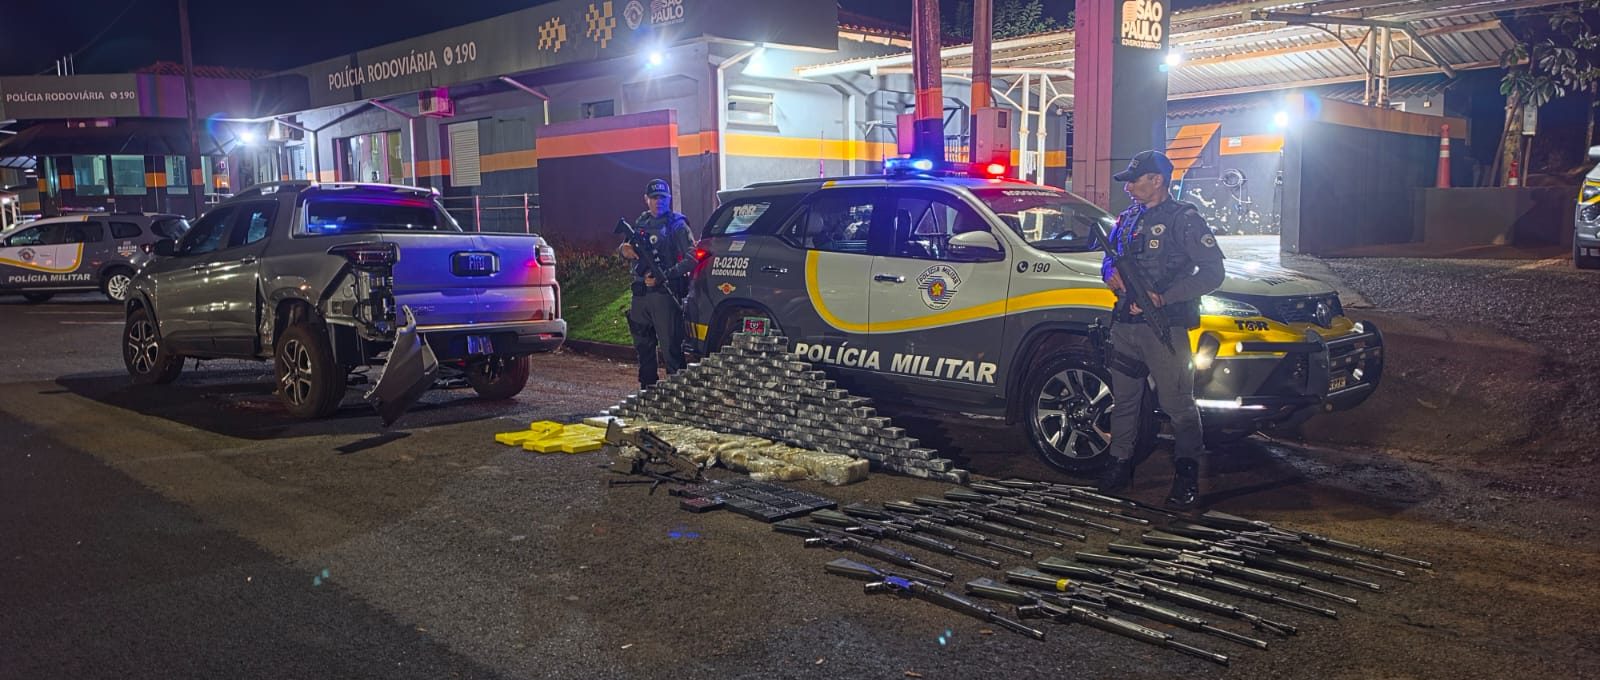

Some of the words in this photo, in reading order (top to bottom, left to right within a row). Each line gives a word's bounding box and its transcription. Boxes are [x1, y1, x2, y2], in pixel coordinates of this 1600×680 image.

[651, 5, 684, 24] PAULO
[1121, 20, 1162, 42] PAULO
[328, 65, 365, 91] POLÍCIA
[367, 50, 438, 83] RODOVIÁRIA
[455, 41, 477, 65] 190
[6, 91, 44, 102] POLÍCIA
[45, 89, 105, 102] RODOVIÁRIA
[119, 91, 135, 100] 190
[712, 256, 750, 269] R-02305
[1032, 262, 1051, 273] 190
[9, 273, 48, 283] POLÍCIA
[50, 273, 91, 281] MILITAR
[793, 341, 880, 370] POLÍCIA
[890, 352, 998, 384] MILITAR
